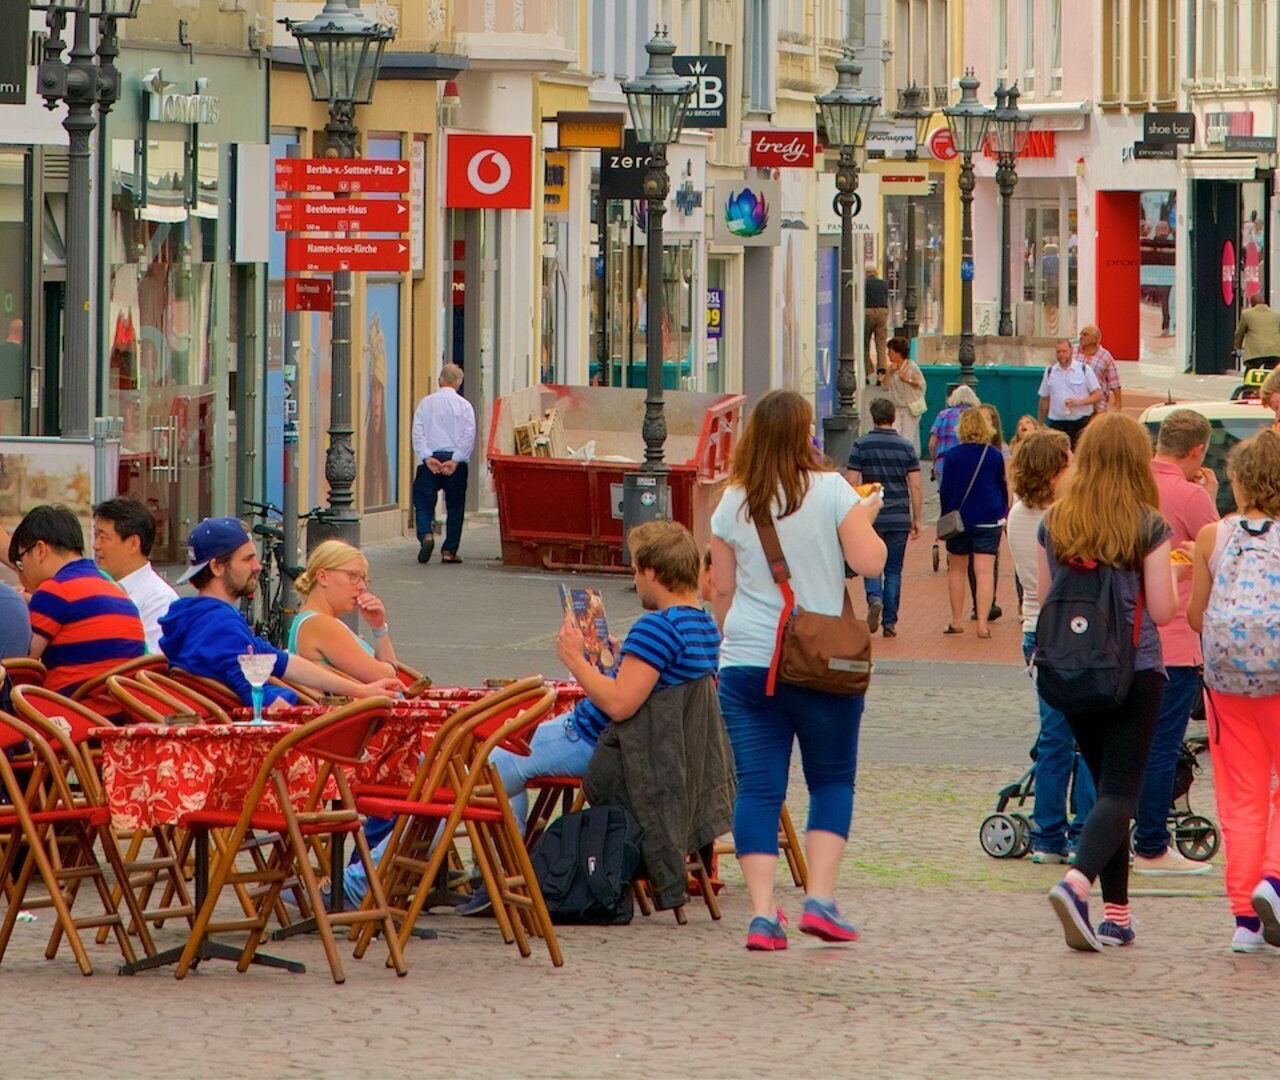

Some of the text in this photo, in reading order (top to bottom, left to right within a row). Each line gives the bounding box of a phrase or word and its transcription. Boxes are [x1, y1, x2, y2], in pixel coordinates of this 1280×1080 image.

[1148, 122, 1171, 135] shoe
[1172, 122, 1191, 135] box
[755, 136, 810, 163] tredy
[305, 203, 368, 215] Beethoven-Haus
